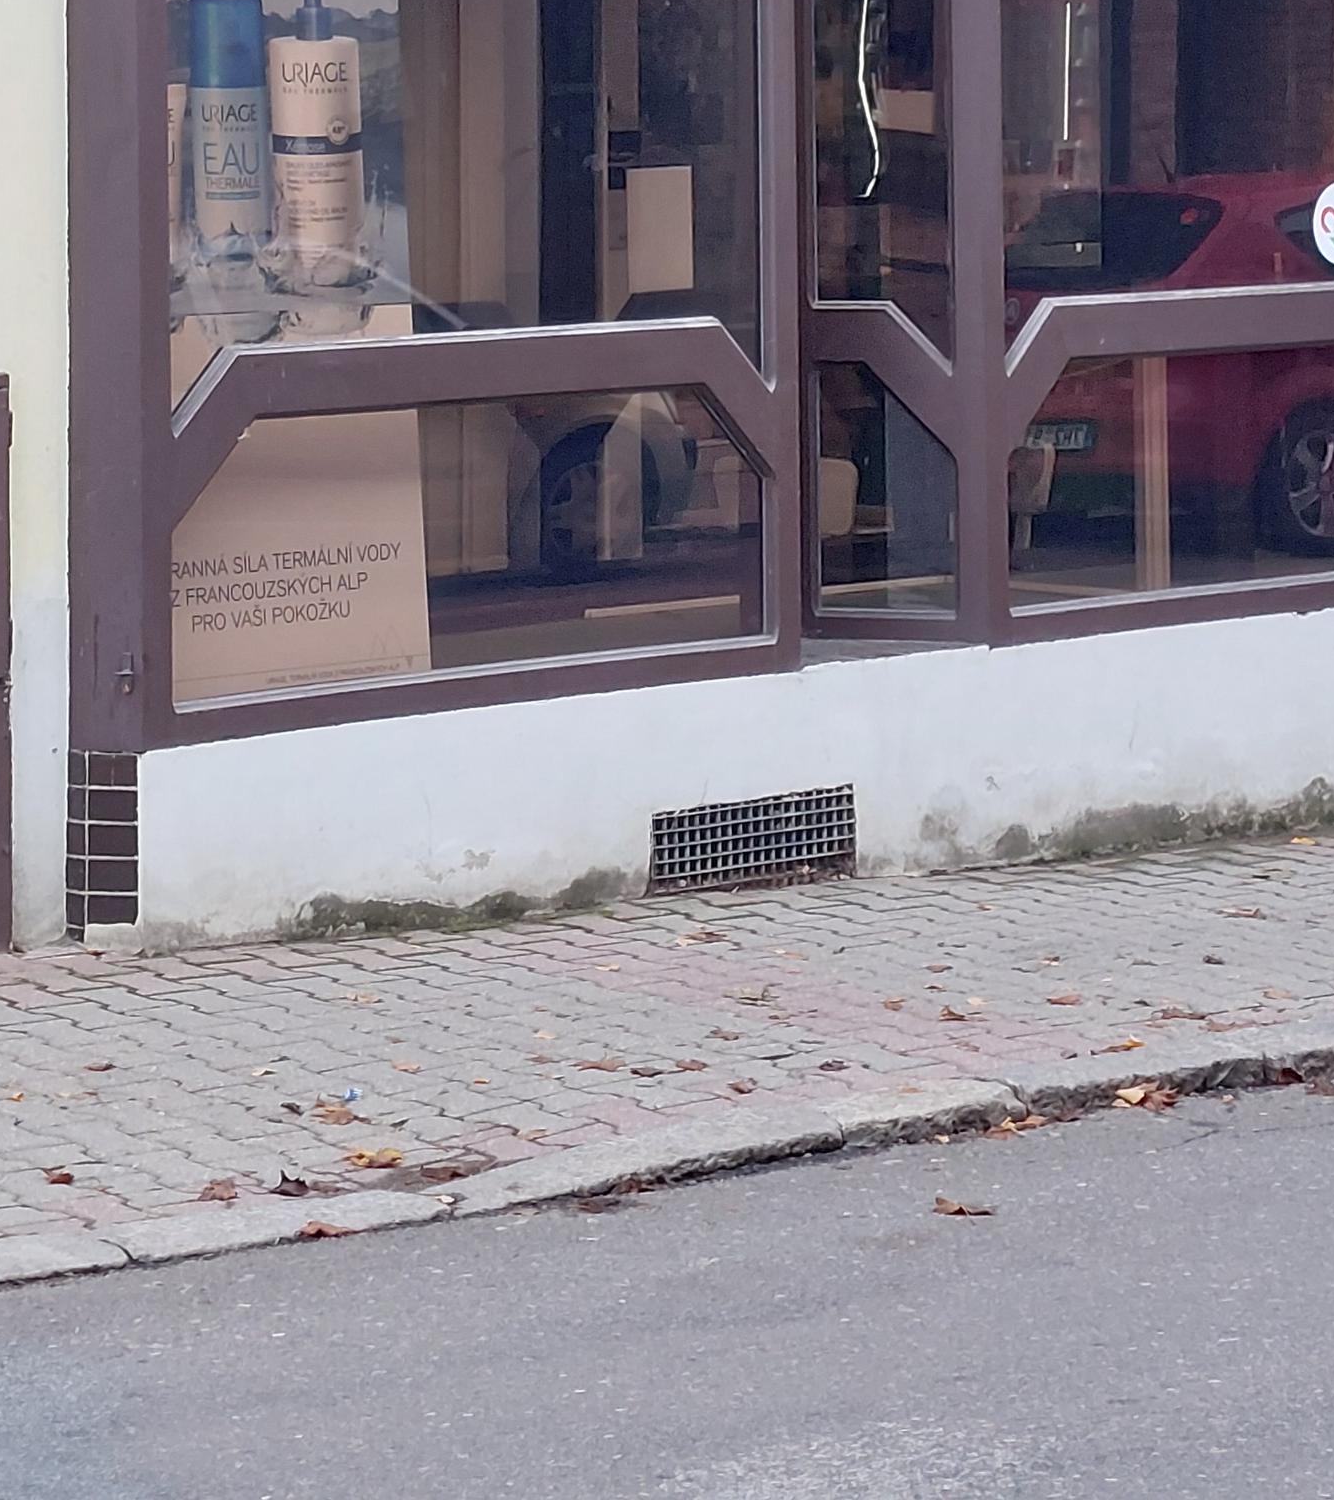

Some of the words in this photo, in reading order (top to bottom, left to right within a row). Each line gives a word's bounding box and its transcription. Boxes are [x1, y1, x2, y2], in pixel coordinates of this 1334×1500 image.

[282, 62, 348, 88] URIAGE
[201, 103, 258, 126] URIAGE
[203, 141, 260, 175] EAU
[206, 176, 260, 190] THERMALE
[232, 551, 268, 575] SÍLA
[272, 541, 353, 570] TERMÁLNÍ
[356, 541, 402, 563] VODY
[185, 574, 332, 606] FRANCOUZSKÝCH
[336, 571, 369, 591] ALP
[192, 612, 227, 633] PRO
[230, 604, 267, 628] VAŠI
[271, 598, 351, 625] POKOŽKU
